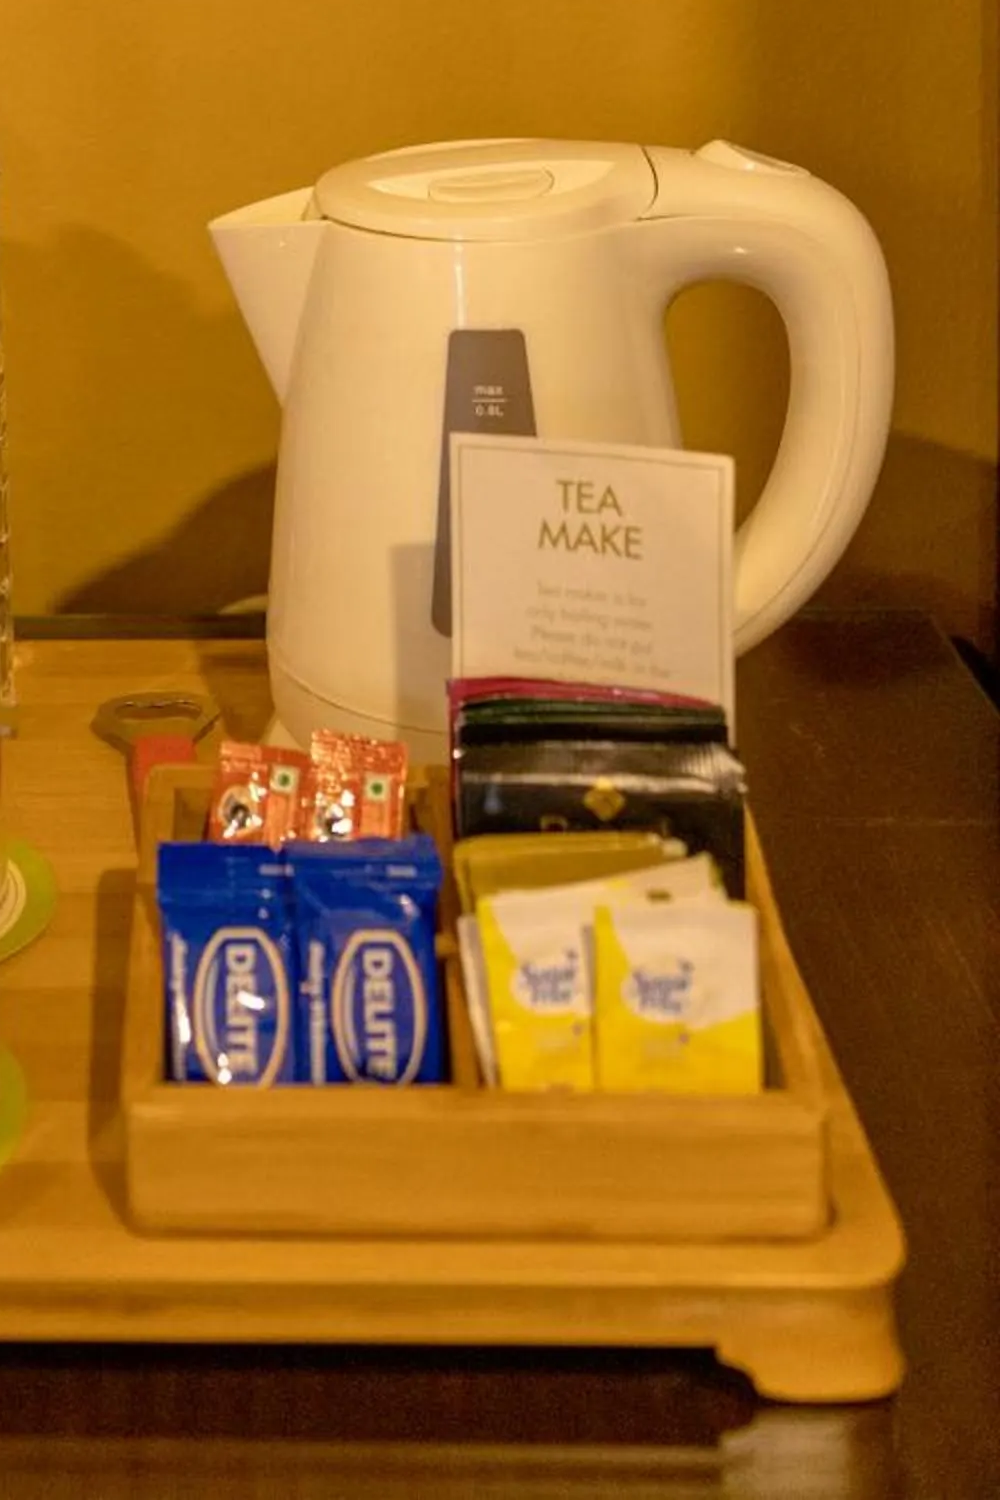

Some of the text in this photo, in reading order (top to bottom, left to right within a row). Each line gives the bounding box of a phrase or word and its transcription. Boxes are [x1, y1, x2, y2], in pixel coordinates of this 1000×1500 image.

[537, 519, 644, 560] MAKE
[556, 478, 623, 518] TEA
[226, 943, 259, 1077] DELITE
[362, 948, 398, 1080] DELITE
